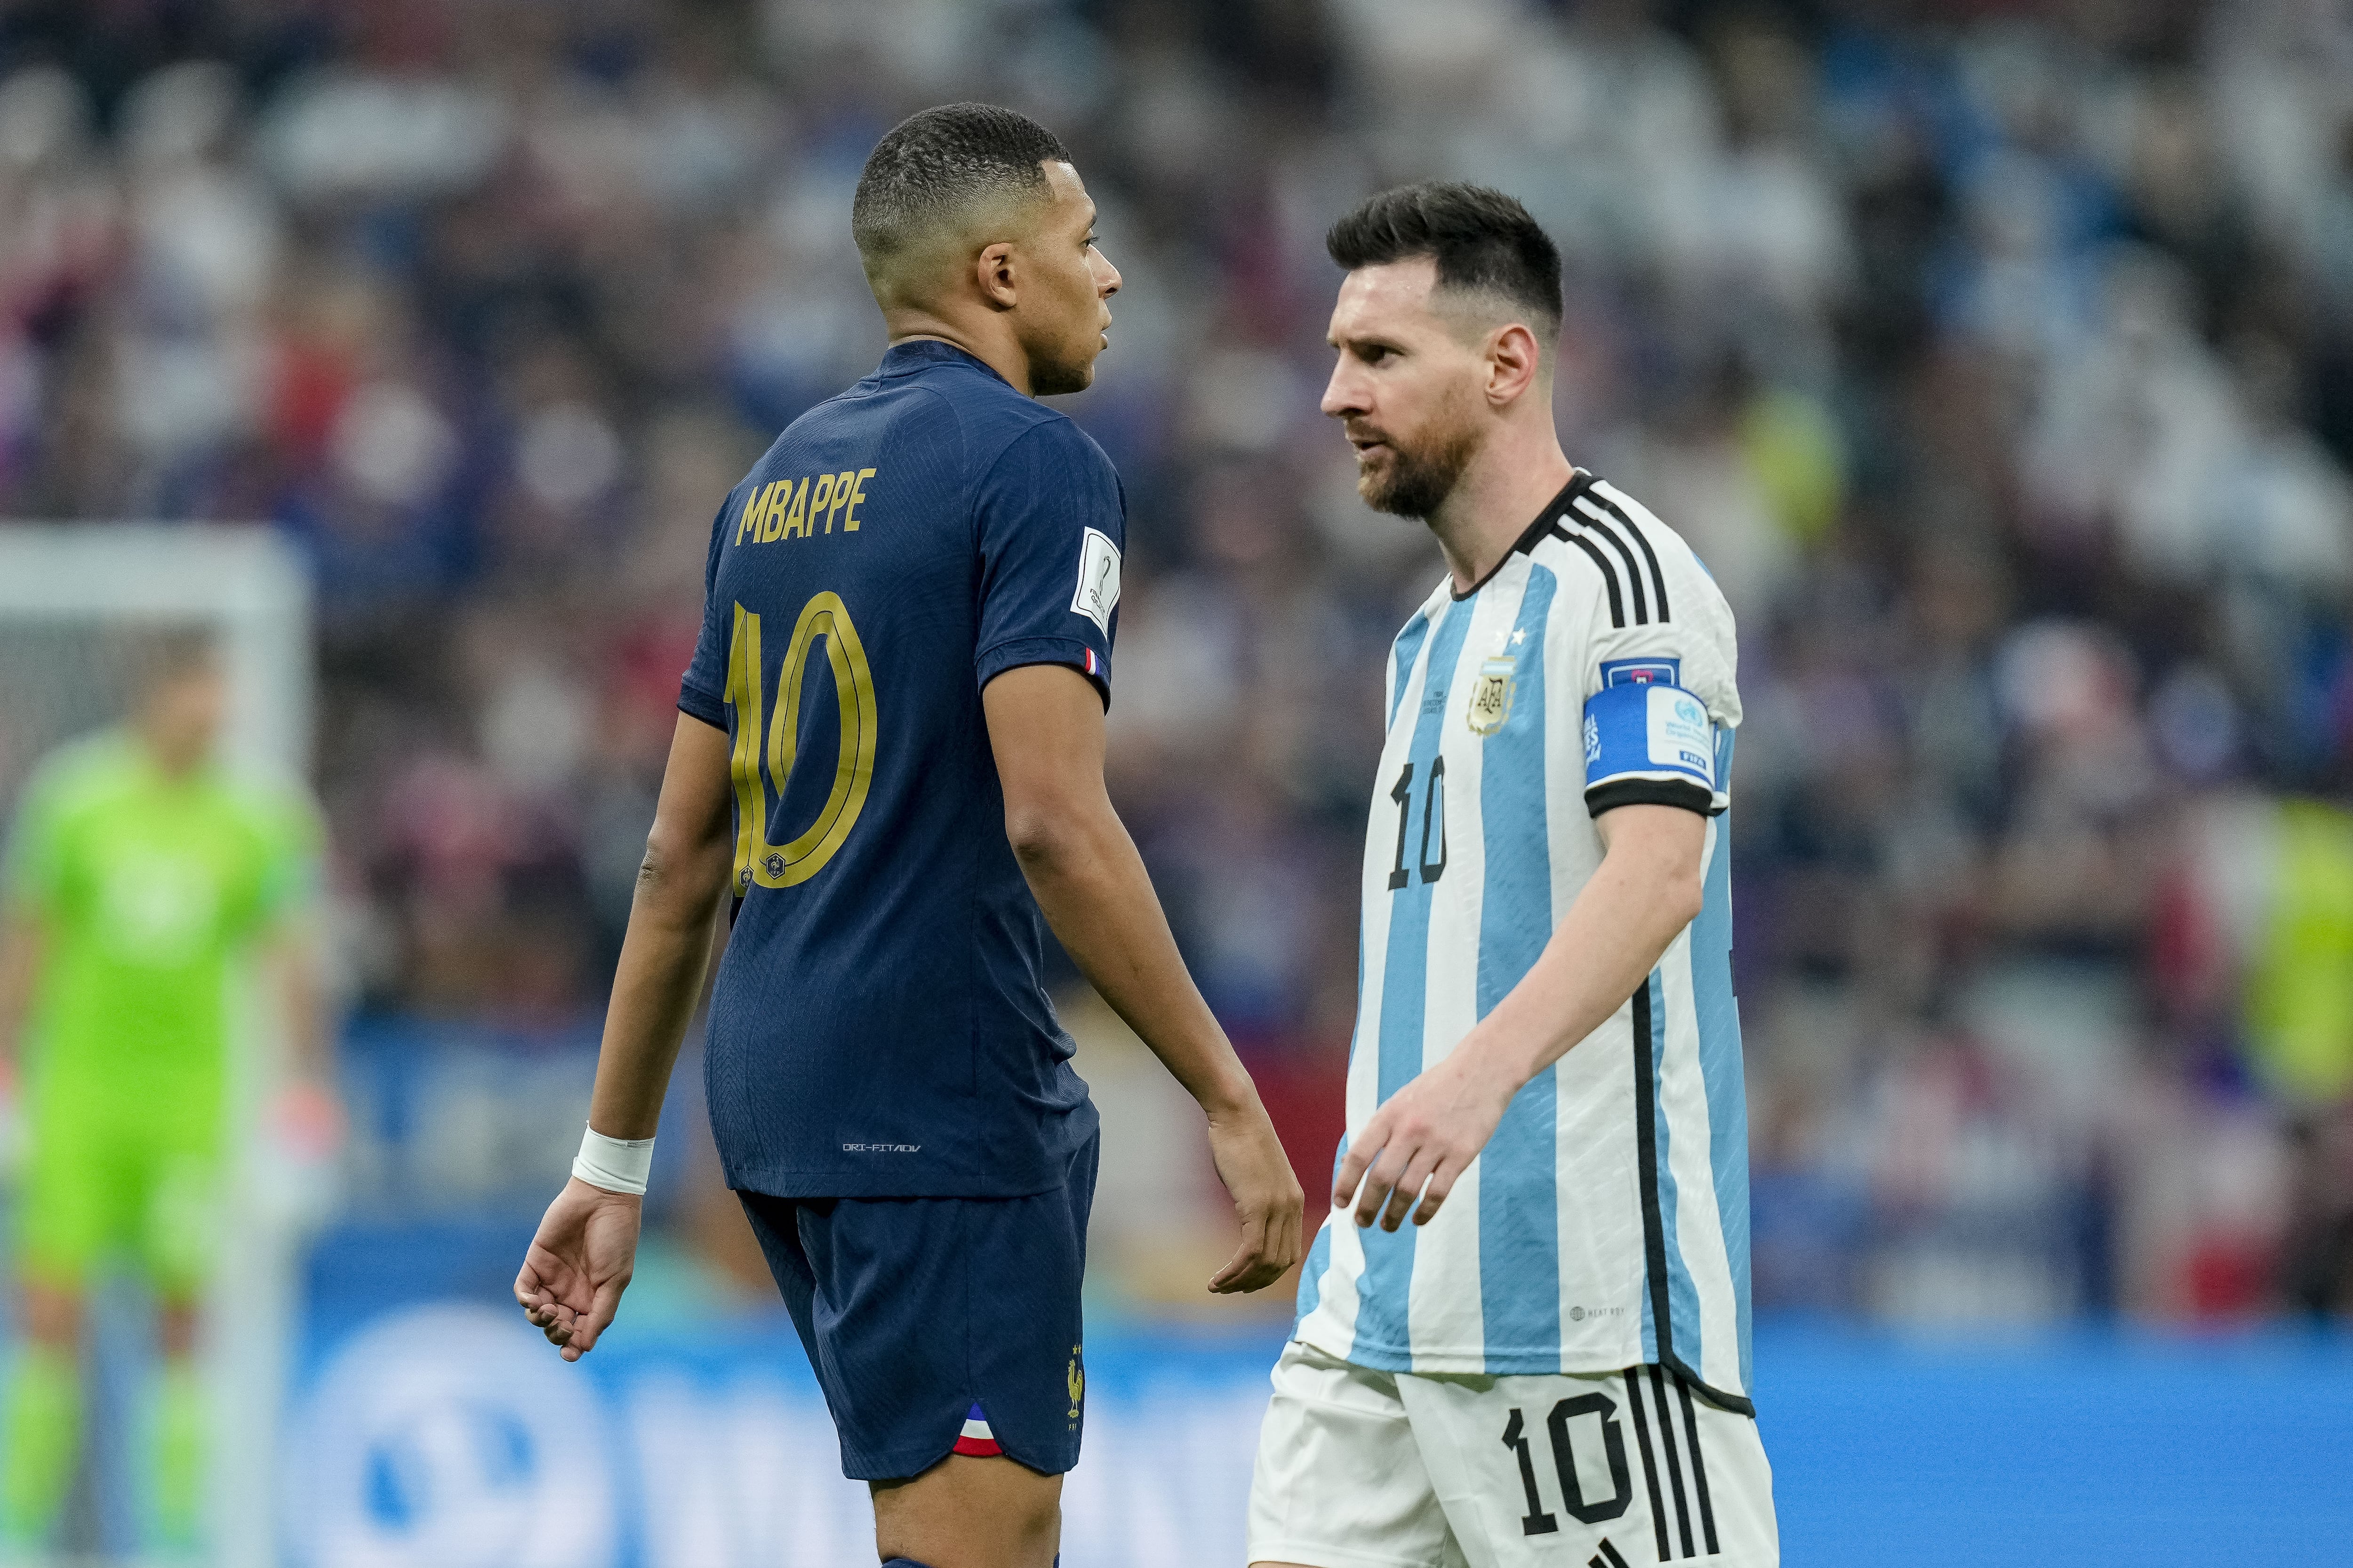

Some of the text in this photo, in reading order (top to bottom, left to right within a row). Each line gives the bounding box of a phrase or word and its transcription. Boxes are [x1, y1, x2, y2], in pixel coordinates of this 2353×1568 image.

[735, 468, 877, 546] MBAPPE
[723, 590, 877, 897] 10
[1388, 755, 1447, 891] 10
[1501, 1392, 1633, 1535] 10
